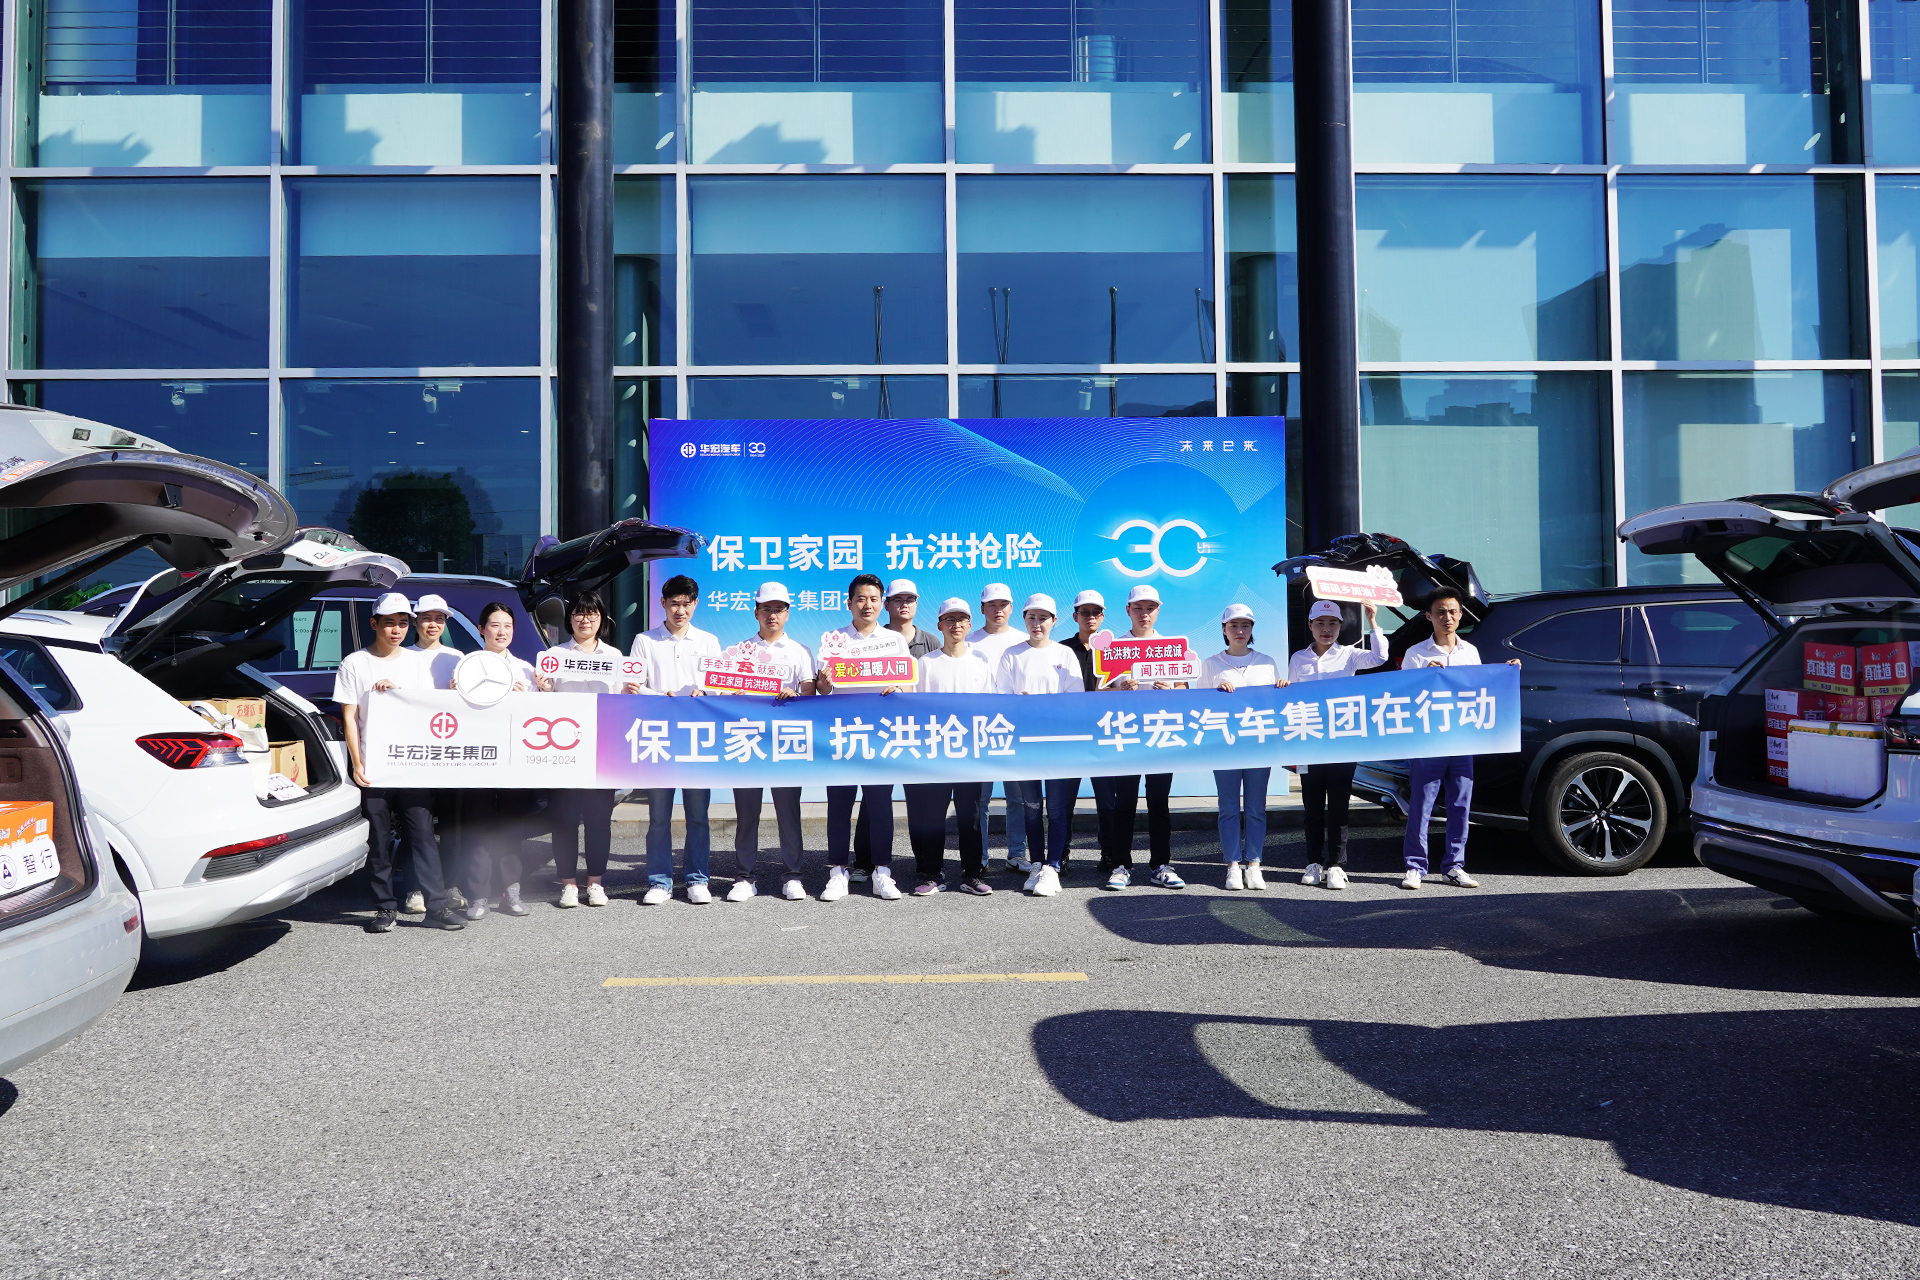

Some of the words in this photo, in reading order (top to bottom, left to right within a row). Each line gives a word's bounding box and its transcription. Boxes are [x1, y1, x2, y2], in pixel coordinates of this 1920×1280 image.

[700, 444, 741, 453] 华宏汽车
[706, 533, 864, 572] 保卫家园
[885, 531, 1043, 571] 抗洪抢险
[1318, 582, 1376, 597] 南矶乡加油!
[707, 590, 851, 612] 华宏集团
[1103, 646, 1141, 661] 抗洪救灾
[564, 658, 614, 672] 华宏汽车
[703, 658, 733, 671] 手牵手
[756, 664, 787, 677] 献爱心
[834, 660, 909, 678] 爱心温暖人间
[1140, 663, 1193, 677] 闻汛而动
[1806, 659, 1836, 679] 真味道
[1864, 662, 1892, 681] 真味道
[709, 674, 744, 688] 保卫家园
[744, 678, 779, 692] 抗洪抢险
[625, 717, 814, 764] 保卫家园
[387, 744, 498, 760] 华宏汽车集团
[525, 755, 577, 765] 1994-2024
[23, 848, 54, 875] 智行
